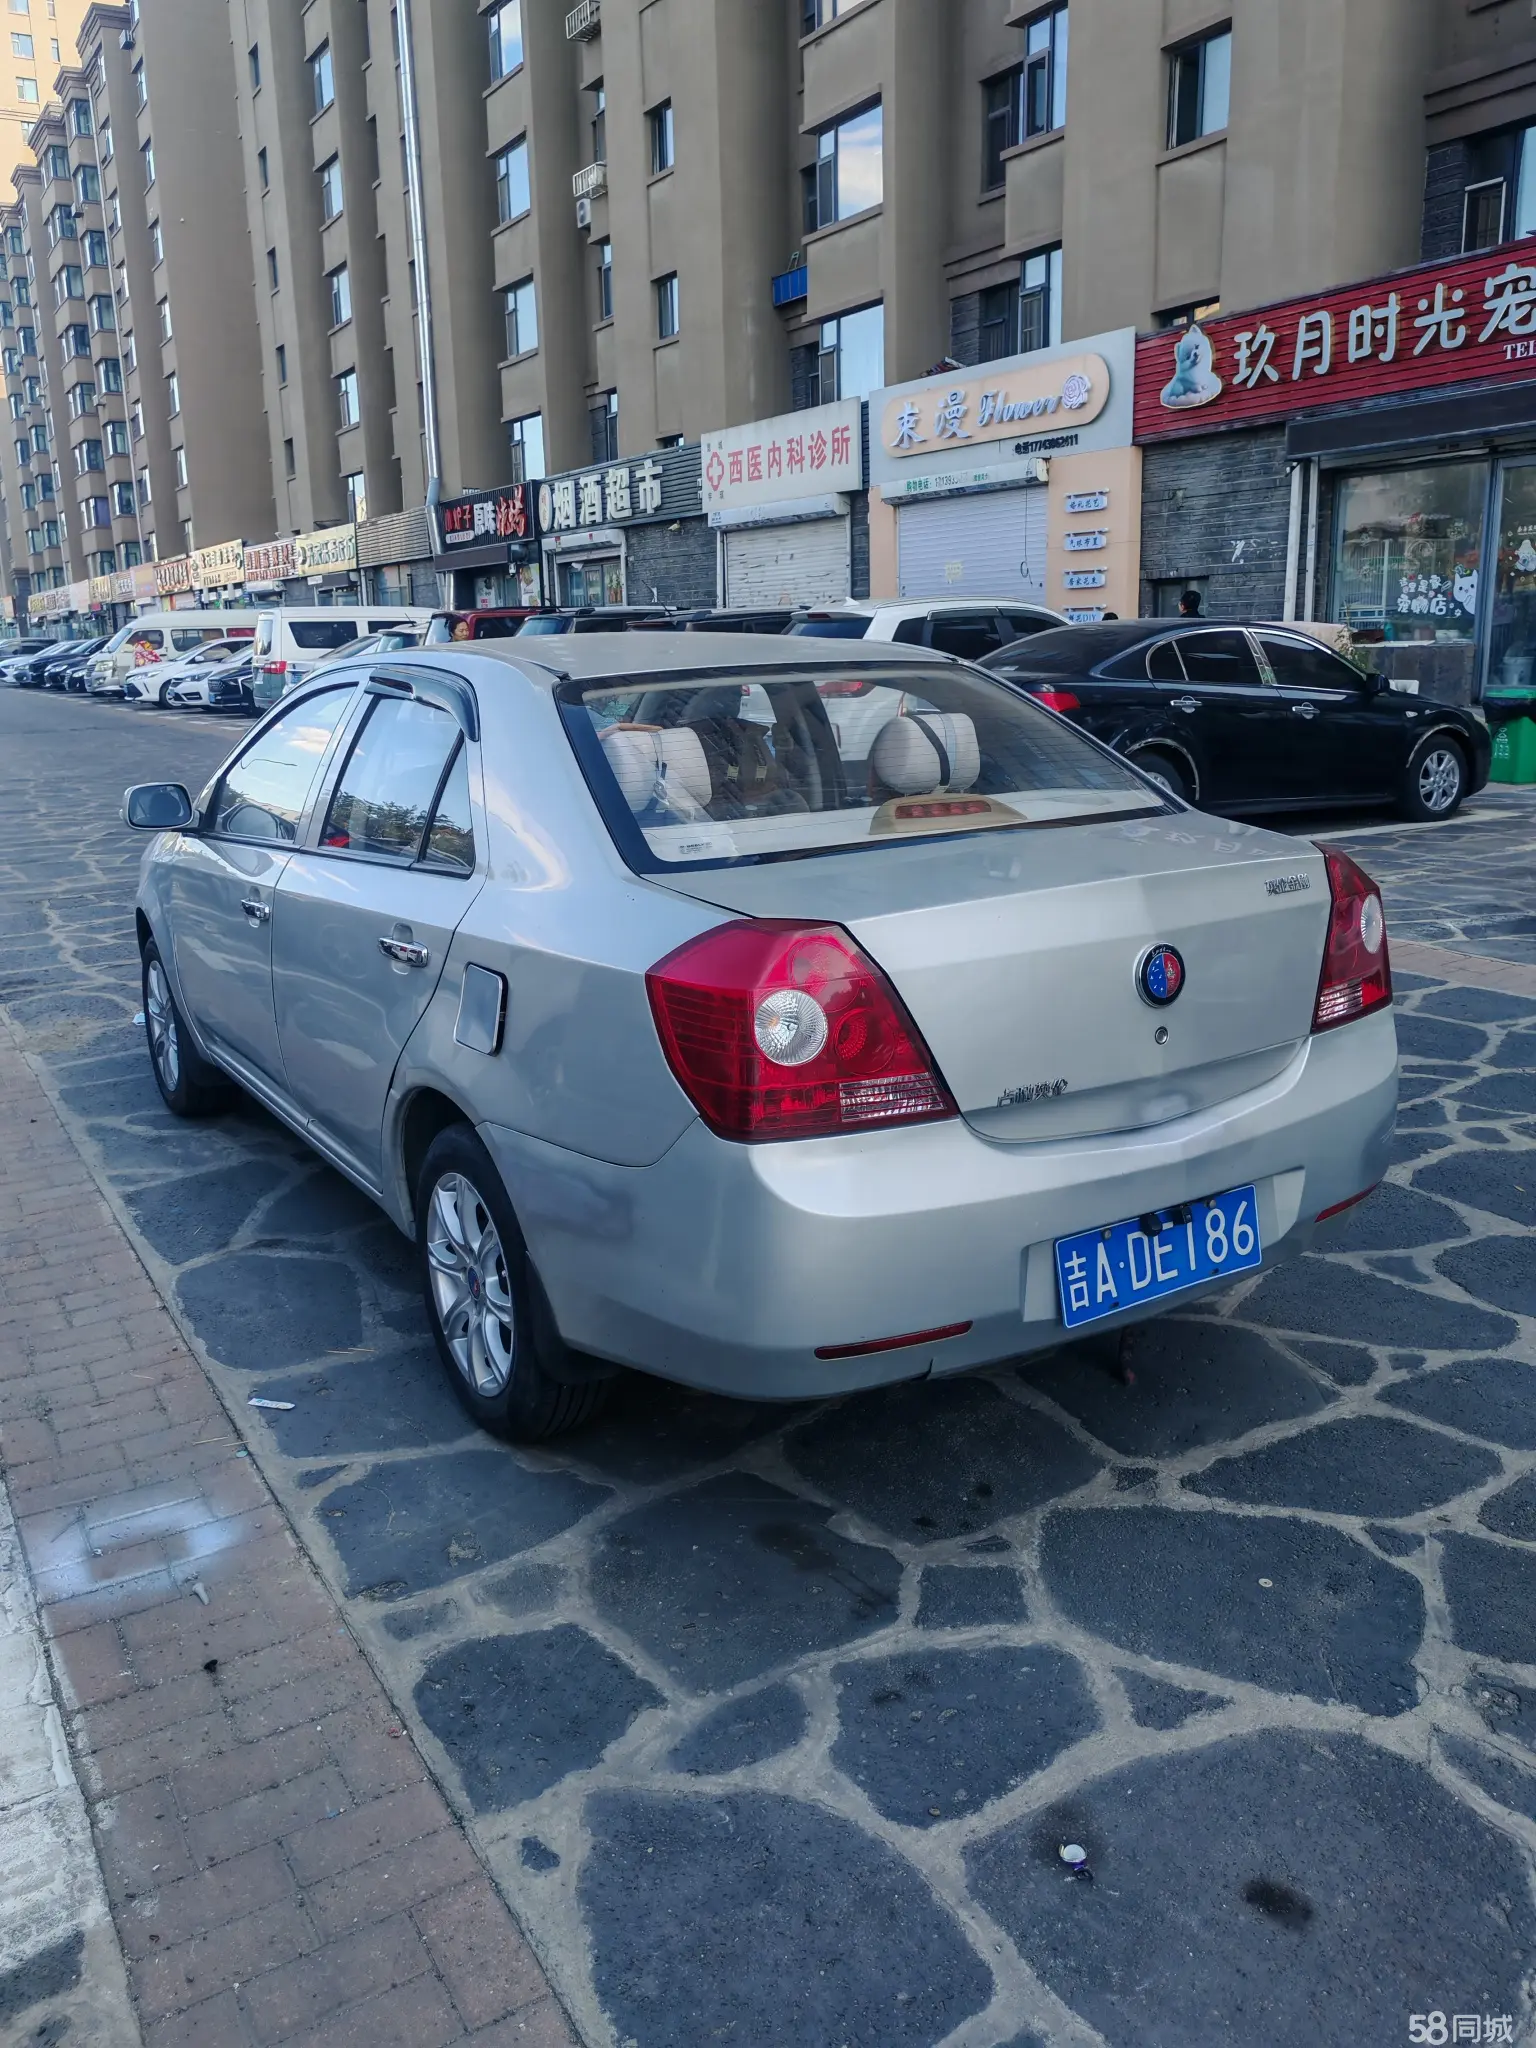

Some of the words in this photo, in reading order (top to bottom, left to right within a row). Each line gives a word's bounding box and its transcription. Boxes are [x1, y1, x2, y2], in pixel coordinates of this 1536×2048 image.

[1231, 263, 1536, 389] 玖月时光宠
[727, 424, 851, 486] 西医内科诊所
[553, 459, 664, 530] 烟酒超市
